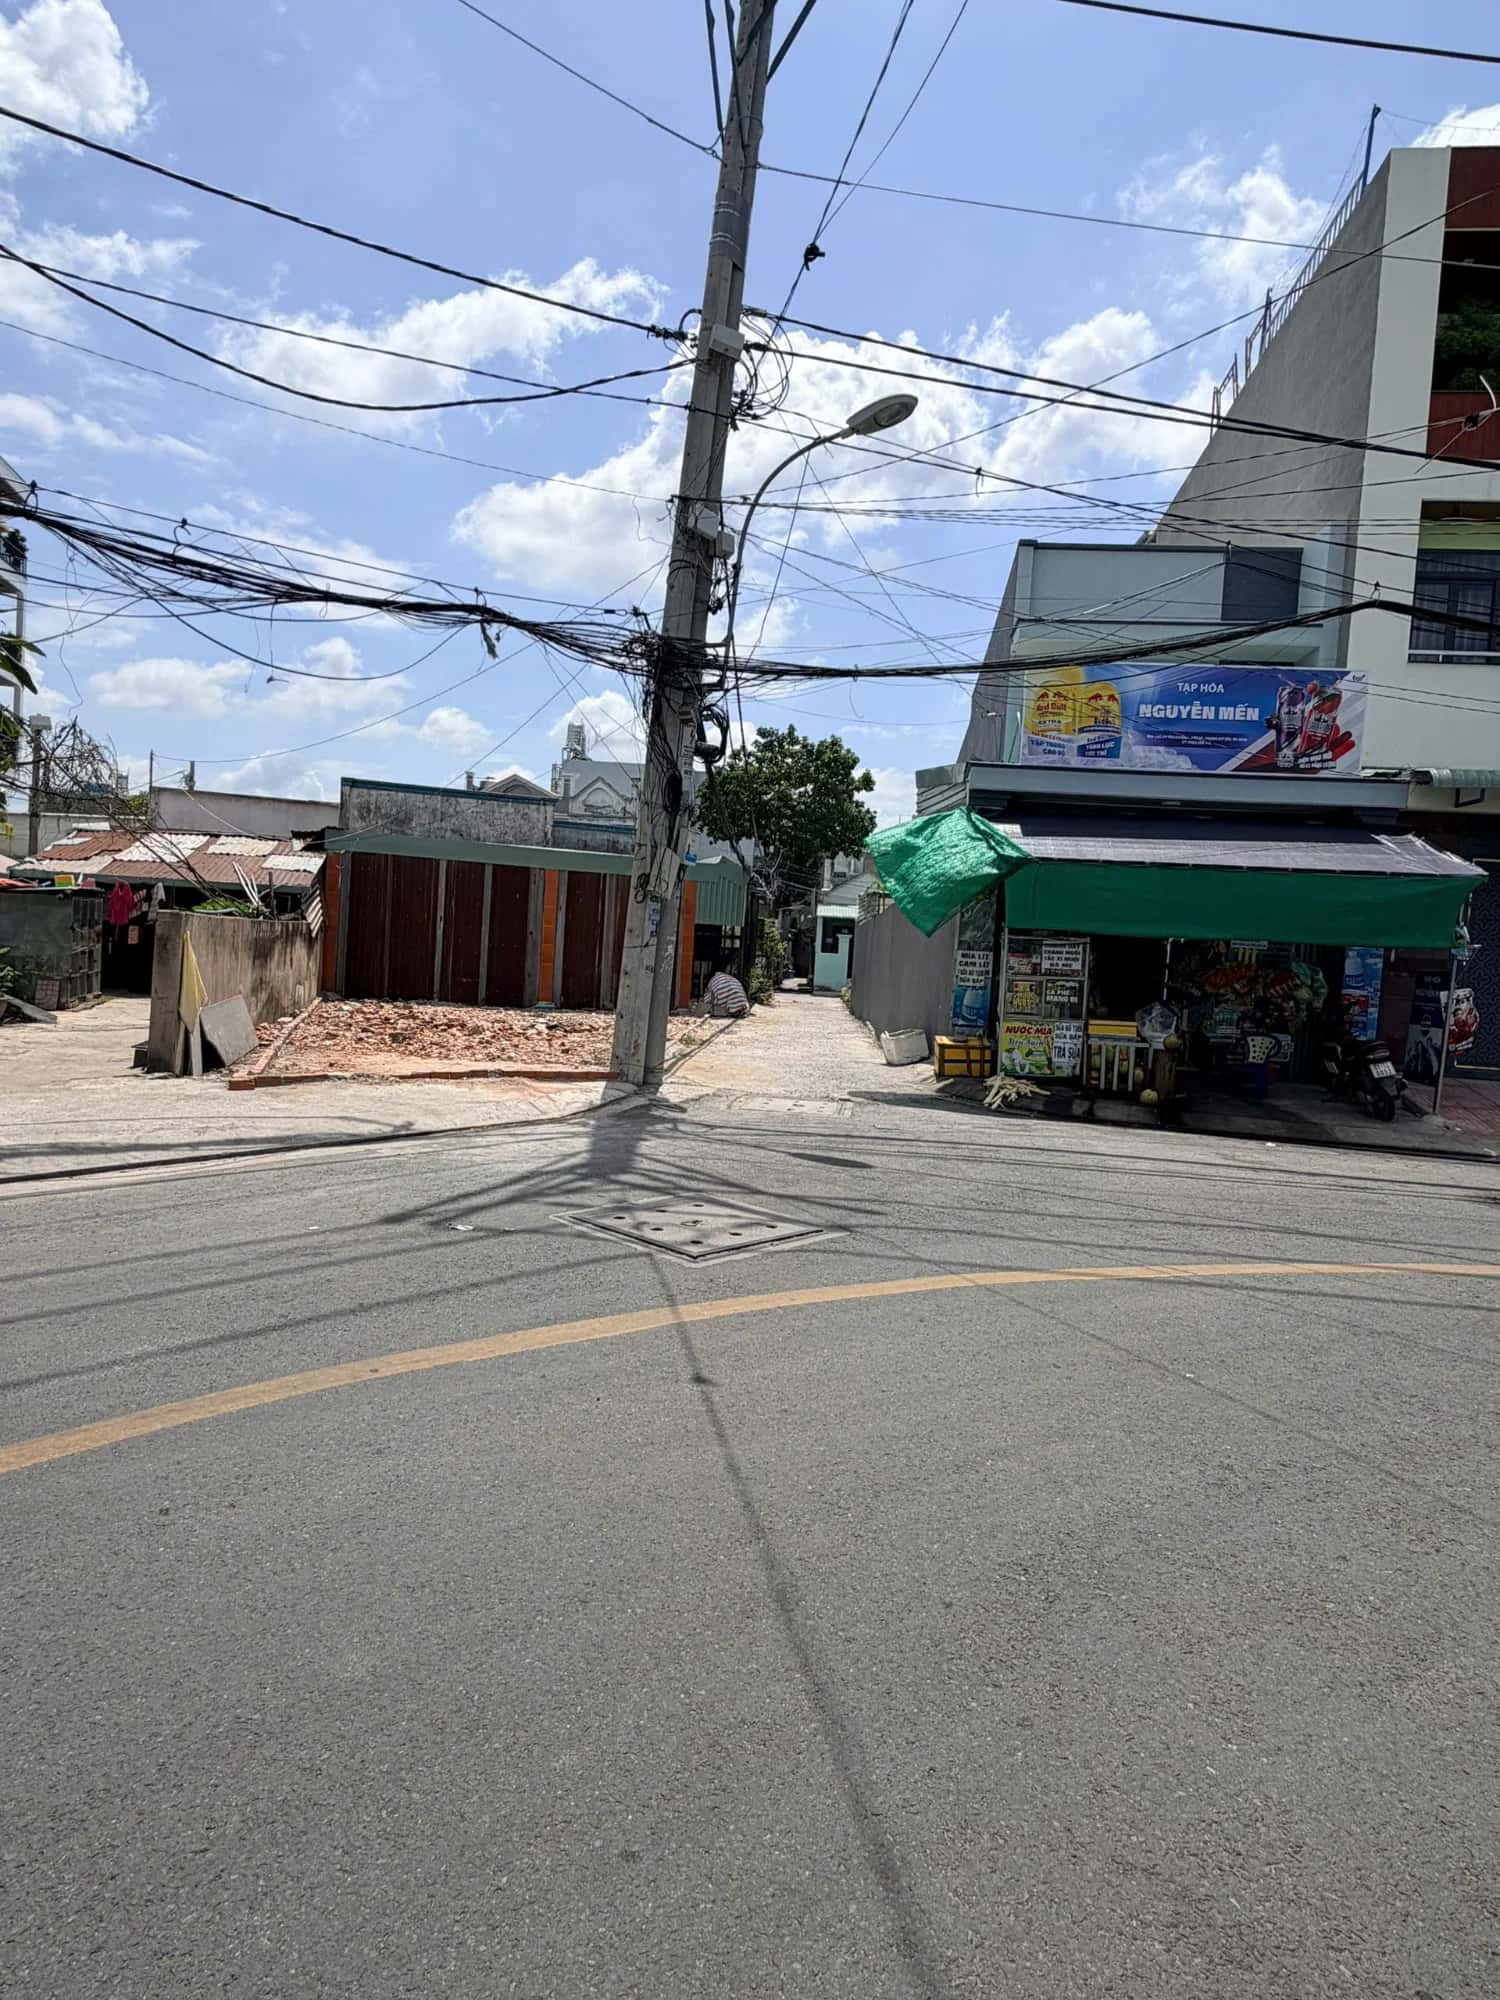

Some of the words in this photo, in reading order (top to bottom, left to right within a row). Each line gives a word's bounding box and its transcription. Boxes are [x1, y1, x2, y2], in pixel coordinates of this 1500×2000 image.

[1177, 682, 1199, 695] TẠP
[1138, 700, 1216, 720] NGUYỄN
[1218, 702, 1260, 721] MẾN
